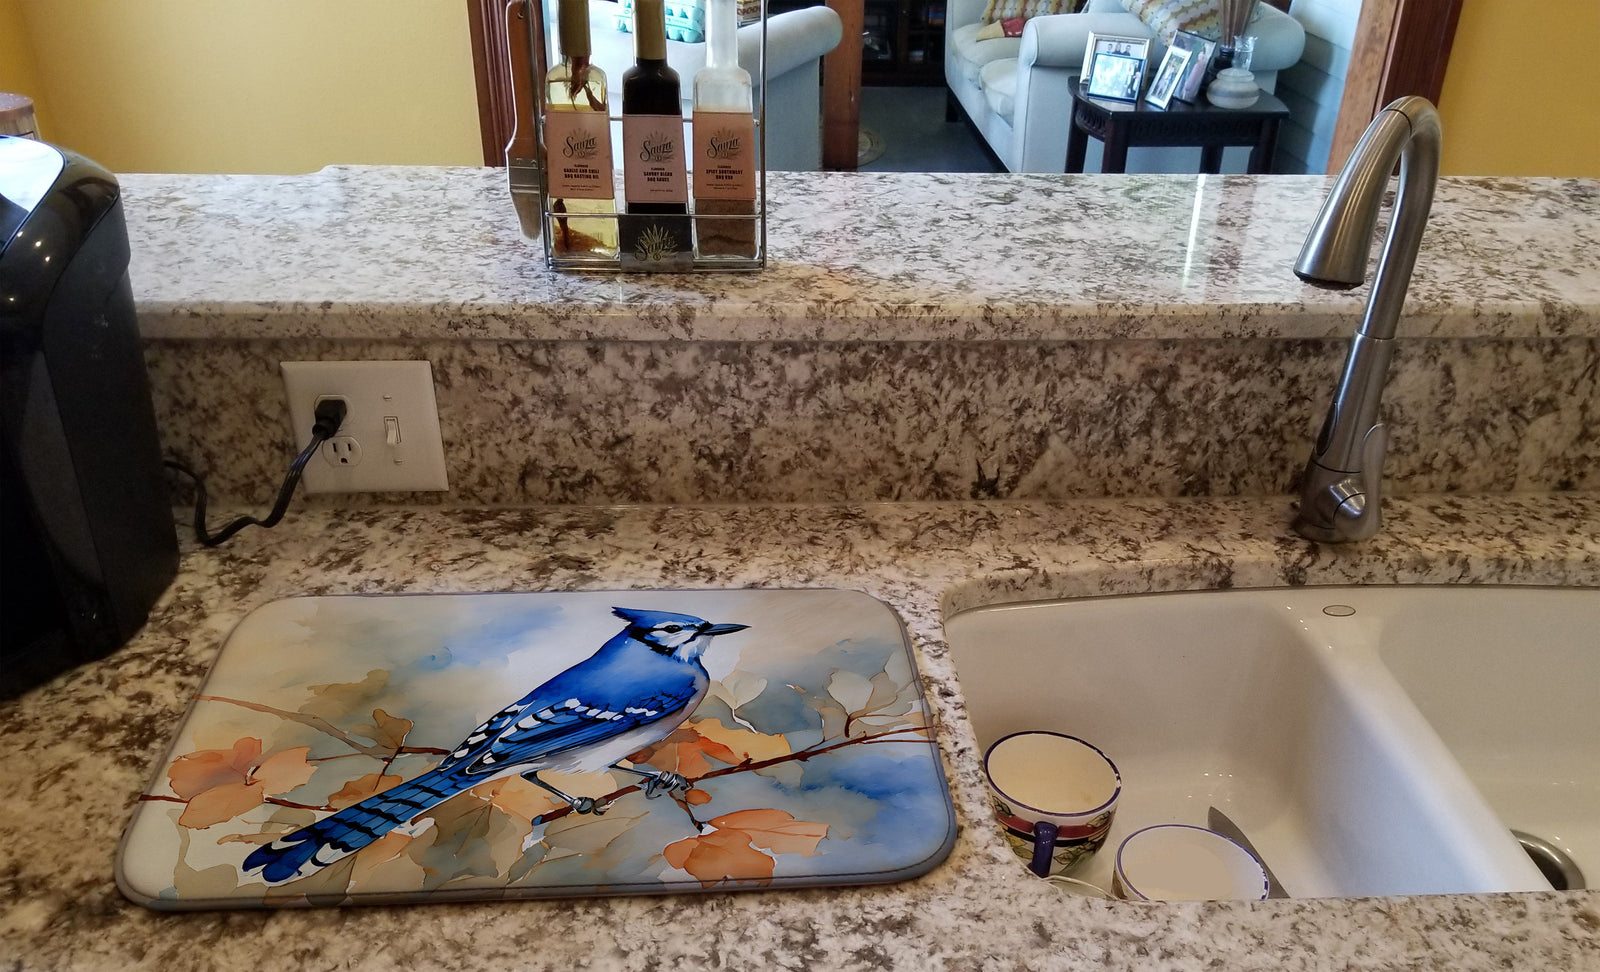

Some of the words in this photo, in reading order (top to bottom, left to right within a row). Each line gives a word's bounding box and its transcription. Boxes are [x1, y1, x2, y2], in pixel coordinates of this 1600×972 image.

[563, 136, 597, 158] Sauza
[640, 140, 673, 162] Sauza
[707, 136, 739, 159] Sauza
